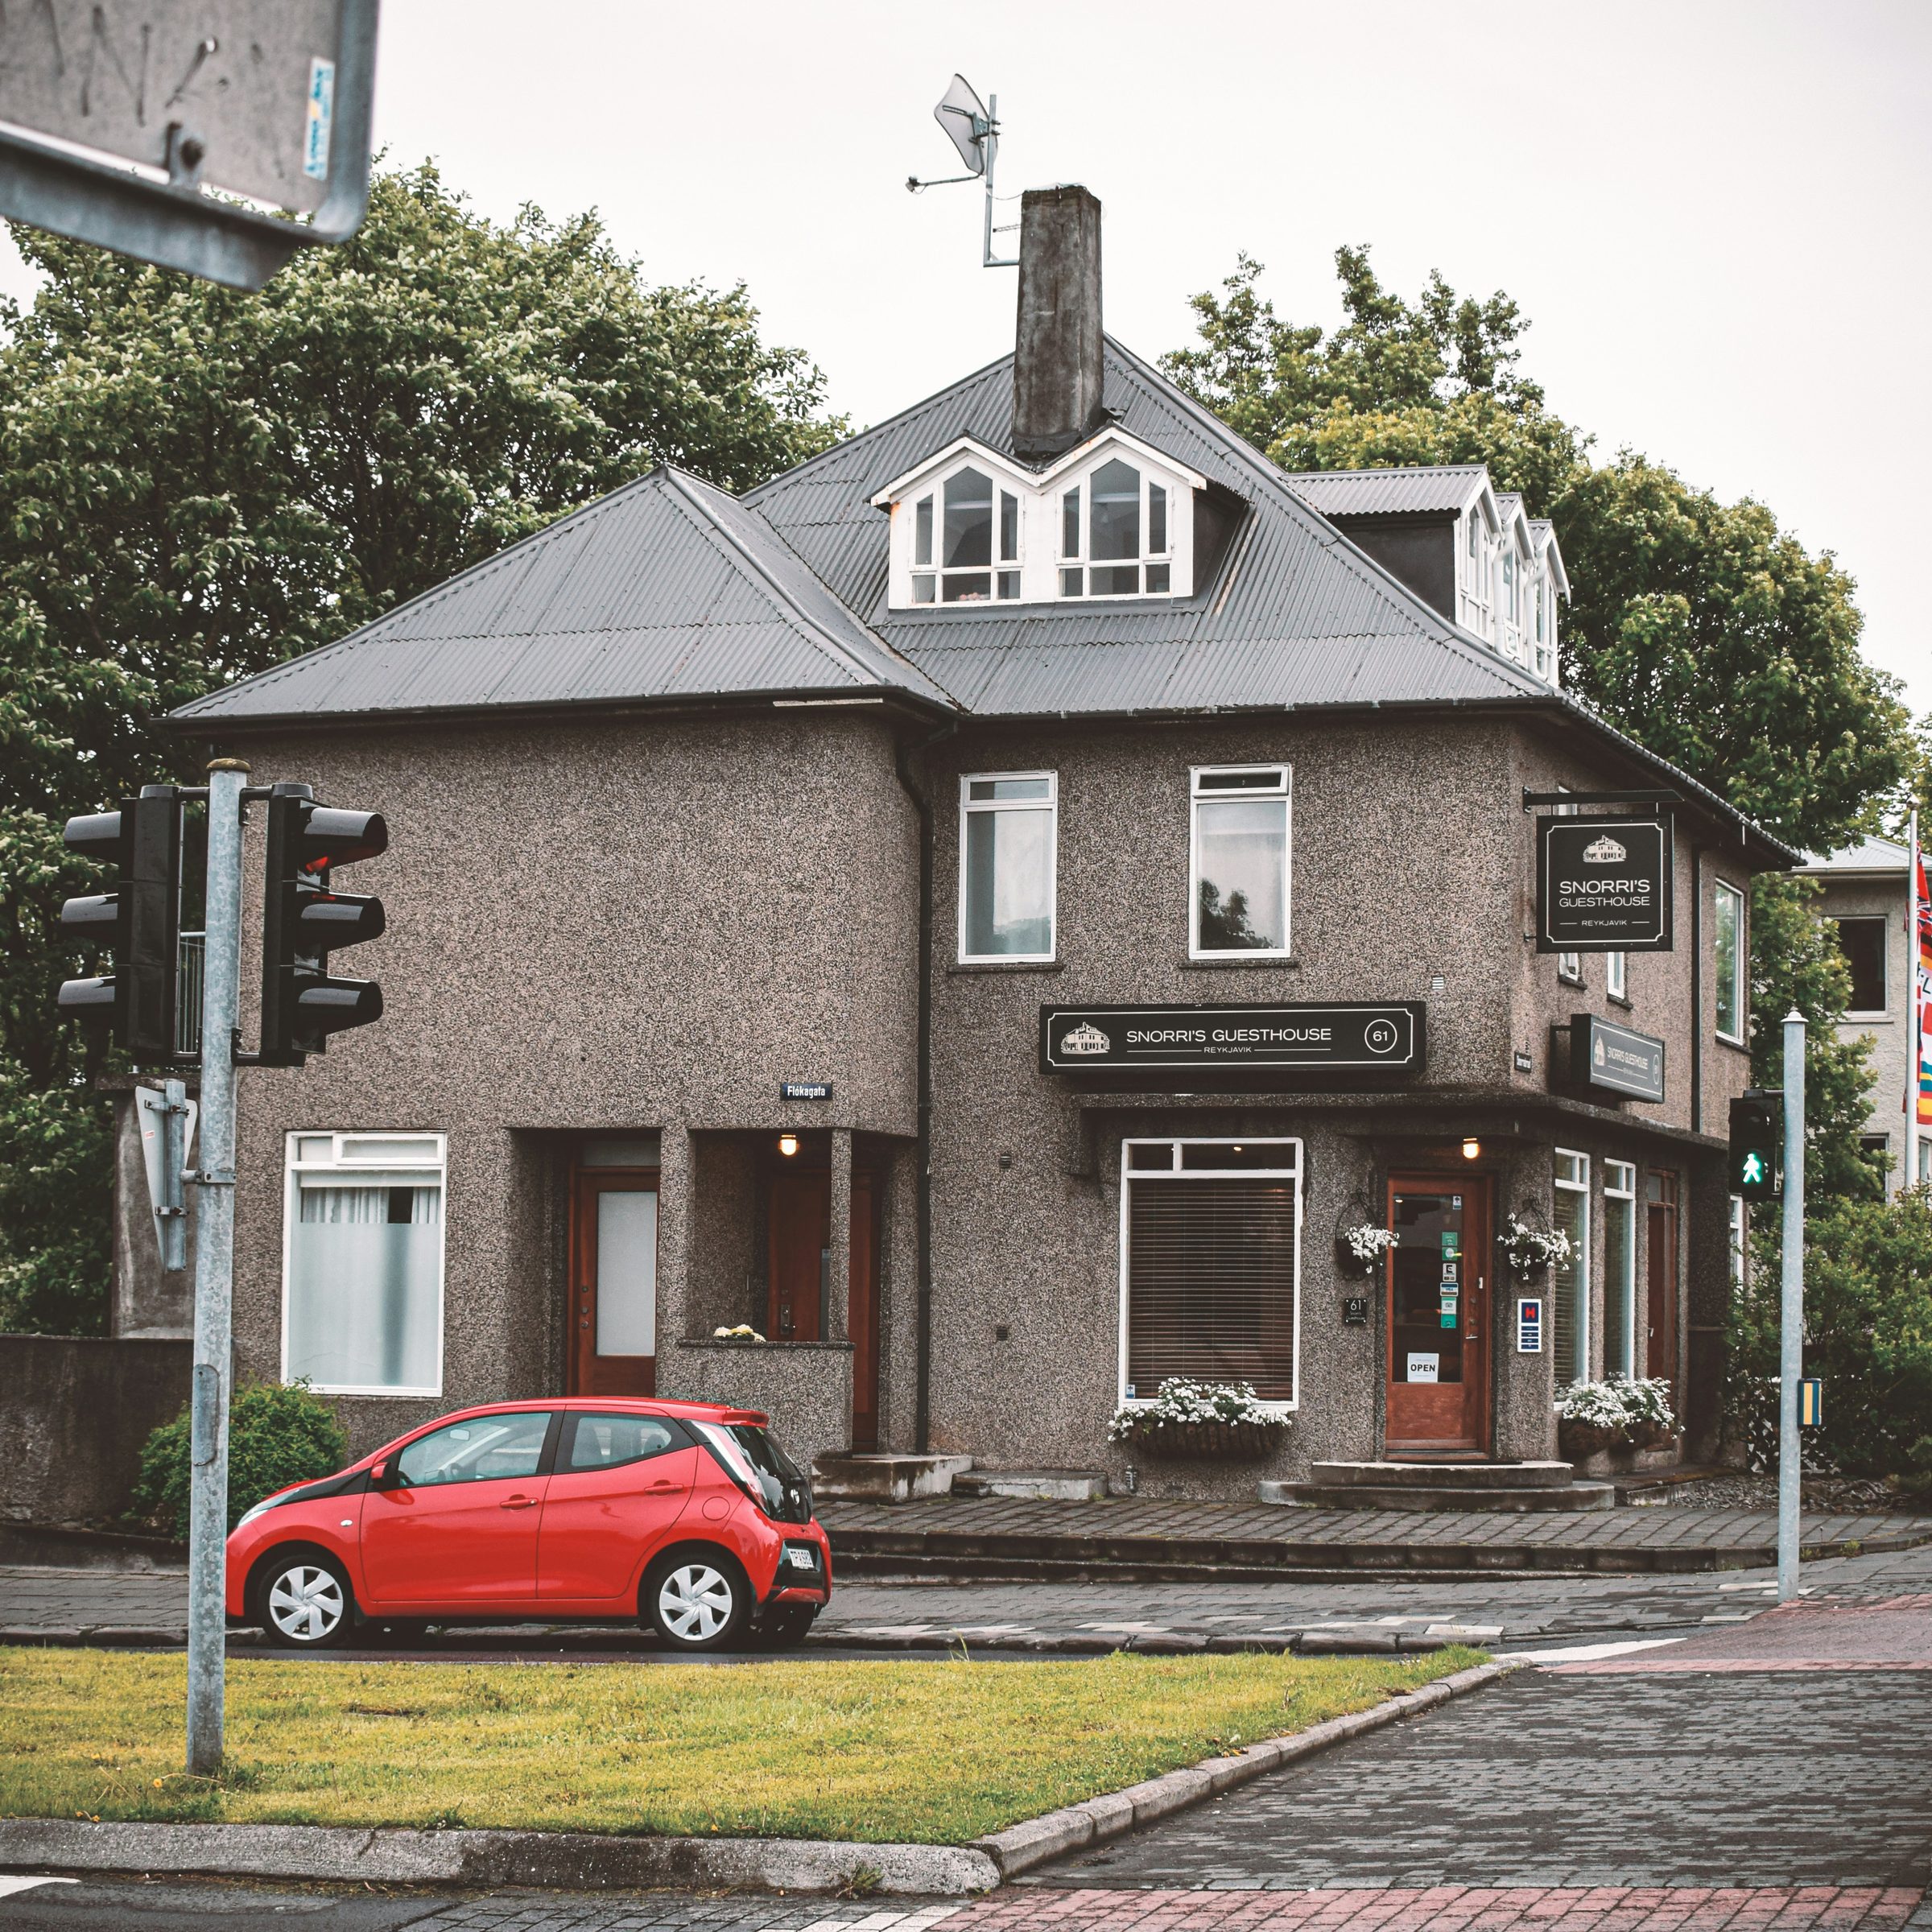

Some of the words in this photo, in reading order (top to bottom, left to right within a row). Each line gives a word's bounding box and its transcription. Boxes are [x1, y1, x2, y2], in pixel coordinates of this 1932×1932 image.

[1559, 879, 1650, 894] SNORRI'S
[1559, 896, 1650, 907] GUESTHOUSE
[1126, 1030, 1206, 1042] SNORRI'S
[1212, 1028, 1331, 1042] GUESTHOUSE
[1373, 1031, 1388, 1042] 61
[786, 1085, 826, 1099] Flókagata
[1350, 1299, 1361, 1311] 61
[1410, 1364, 1435, 1372] OPEN
